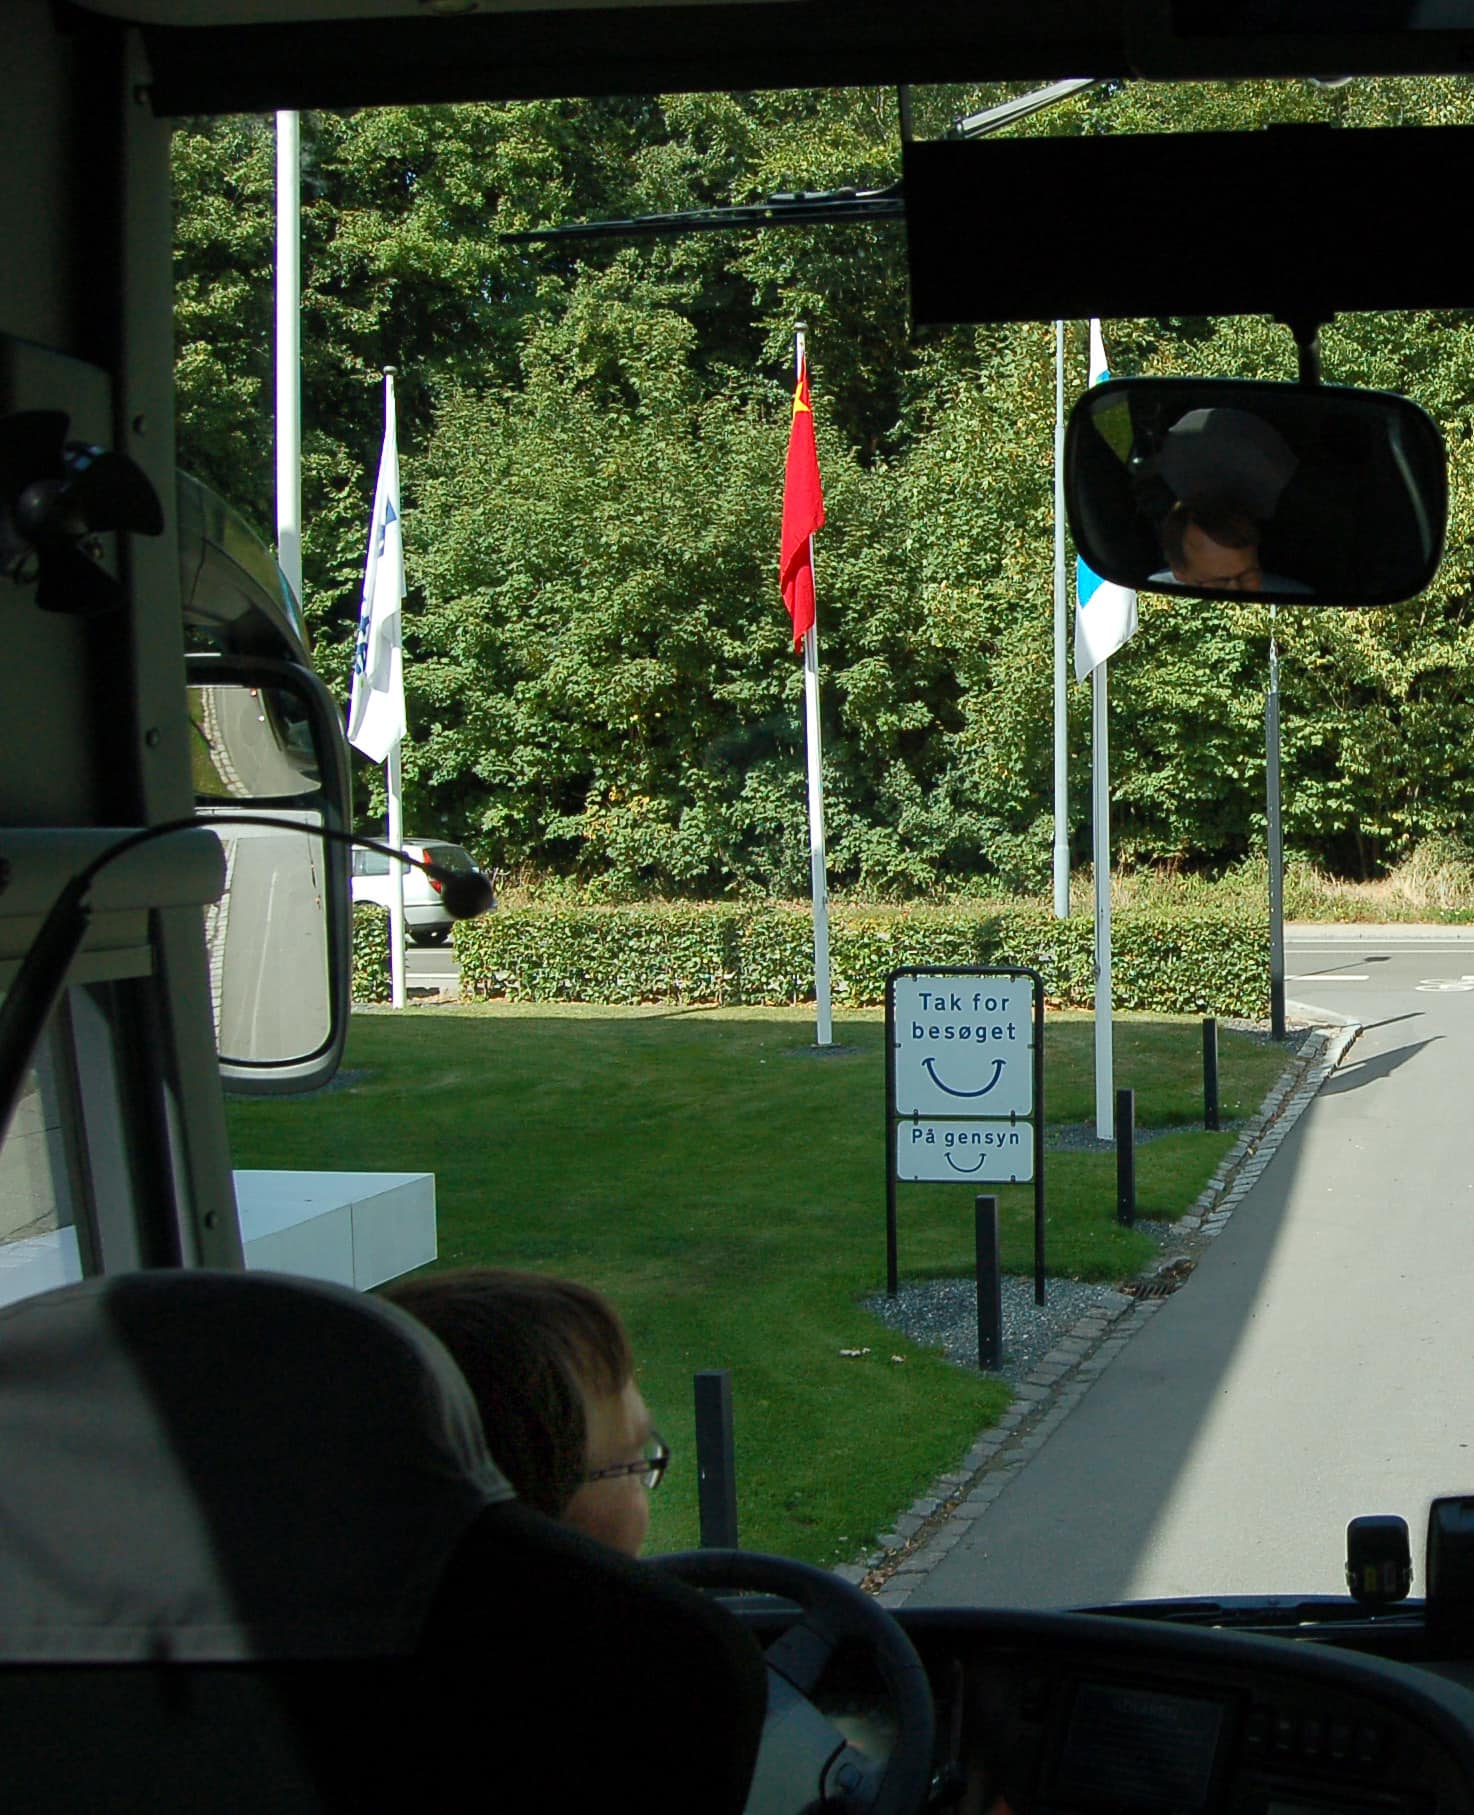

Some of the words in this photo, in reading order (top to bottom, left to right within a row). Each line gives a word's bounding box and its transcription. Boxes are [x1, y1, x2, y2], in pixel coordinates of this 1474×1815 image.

[918, 992, 962, 1012] Tak
[972, 992, 1010, 1012] for
[912, 1021, 1017, 1043] besøget
[911, 1128, 936, 1145] På
[944, 1130, 1020, 1148] gensyn
